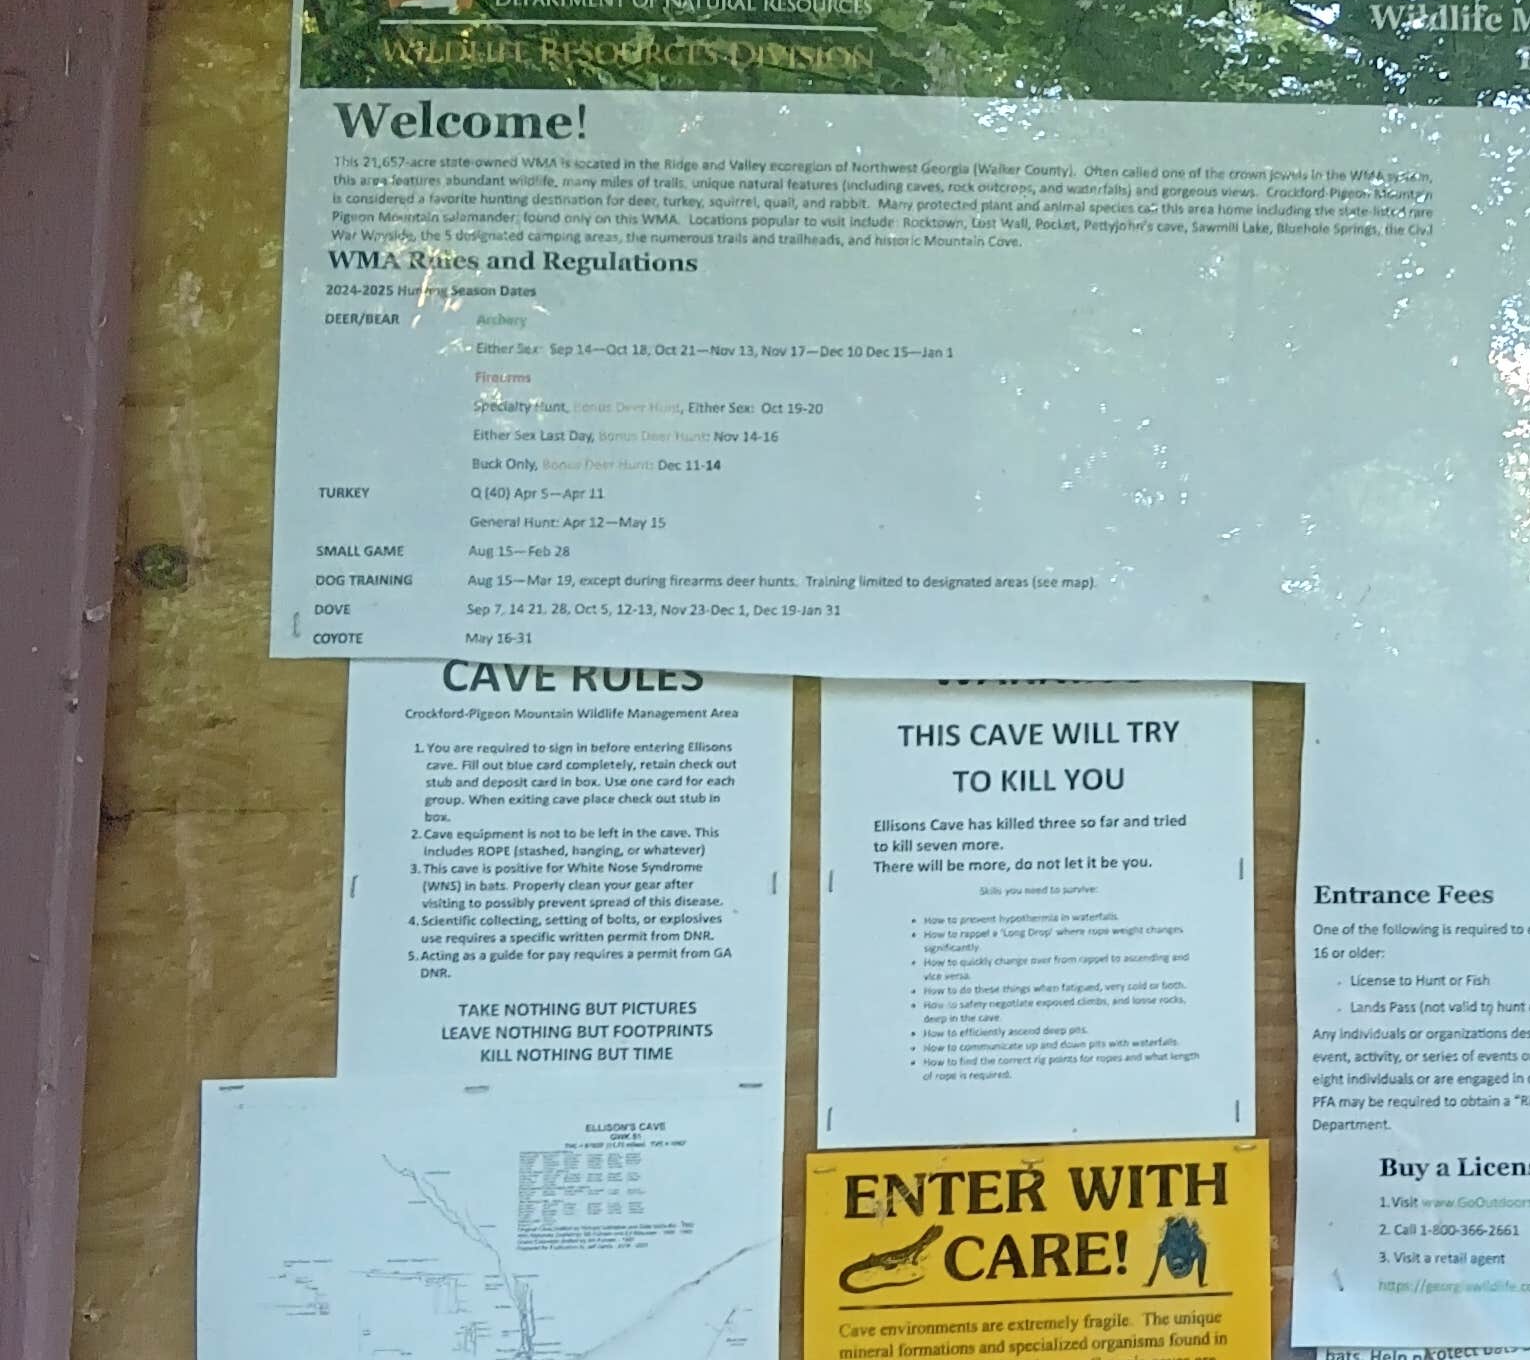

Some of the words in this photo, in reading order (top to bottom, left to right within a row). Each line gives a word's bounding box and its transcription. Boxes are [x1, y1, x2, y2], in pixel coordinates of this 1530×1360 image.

[1369, 4, 1502, 33] Wildlife
[332, 99, 586, 140] Welcome!
[327, 250, 401, 270] WMA
[486, 250, 536, 271] and
[543, 251, 698, 276] Regulations
[326, 284, 394, 296] 2024-2025
[451, 285, 497, 296] Season
[500, 286, 536, 297] Dates
[324, 312, 400, 327] DEER/BEAR
[318, 486, 370, 499] TURKEY
[316, 545, 361, 558] SMALL
[363, 545, 404, 557] GAME
[315, 574, 346, 587] DOG
[348, 574, 413, 587] TRAINING
[314, 603, 351, 616] DOVE
[312, 632, 363, 645] COYOTE
[443, 659, 556, 692] CAVE
[573, 666, 704, 691] RULES
[404, 707, 511, 722] Crockford-Pigeon
[513, 708, 574, 720] Mountain
[576, 707, 625, 720] Wildlife
[626, 707, 708, 721] Management
[709, 707, 739, 719] Area
[897, 724, 961, 747] THIS
[969, 723, 1044, 747] CAVE
[1052, 721, 1120, 745] WILL
[1126, 720, 1180, 744] TRY
[952, 770, 992, 793] TO
[1001, 769, 1057, 793] KILL
[1063, 767, 1124, 791] YOU
[873, 819, 927, 833] Ellisons
[929, 818, 964, 832] Cave
[968, 817, 993, 831] has
[996, 816, 1035, 830] killed
[1038, 816, 1077, 830] three
[1080, 818, 1097, 829] so
[1099, 815, 1120, 828] far
[1123, 814, 1150, 828] and
[1153, 813, 1187, 828] tried
[872, 860, 915, 873] There
[917, 859, 943, 873] will
[946, 859, 965, 872] be
[968, 860, 1011, 873] more,
[1014, 857, 1033, 871] do
[1036, 858, 1061, 870] not
[1064, 856, 1084, 870] let
[1086, 856, 1097, 869] it
[1100, 855, 1119, 869] be
[1121, 858, 1153, 871] you.
[1314, 885, 1431, 905] Entrance
[1437, 884, 1494, 905] Fees
[457, 1003, 500, 1017] TAKE
[504, 1002, 581, 1017] NOTHING
[585, 1001, 618, 1016] BUT
[621, 1001, 697, 1016] PICTURES
[441, 1026, 491, 1041] LEAVE
[495, 1025, 572, 1040] NOTHING
[576, 1024, 610, 1039] BUT
[613, 1023, 714, 1039] FOOTPRINTS
[480, 1048, 513, 1063] KILL
[516, 1047, 593, 1062] NOTHING
[597, 1047, 630, 1062] BUT
[632, 1046, 673, 1061] TIME
[1379, 1157, 1430, 1182] Buy
[1435, 1162, 1451, 1177] a
[844, 1169, 1048, 1219] ENTER
[1067, 1161, 1229, 1212] WITH
[944, 1229, 1128, 1282] CARE!
